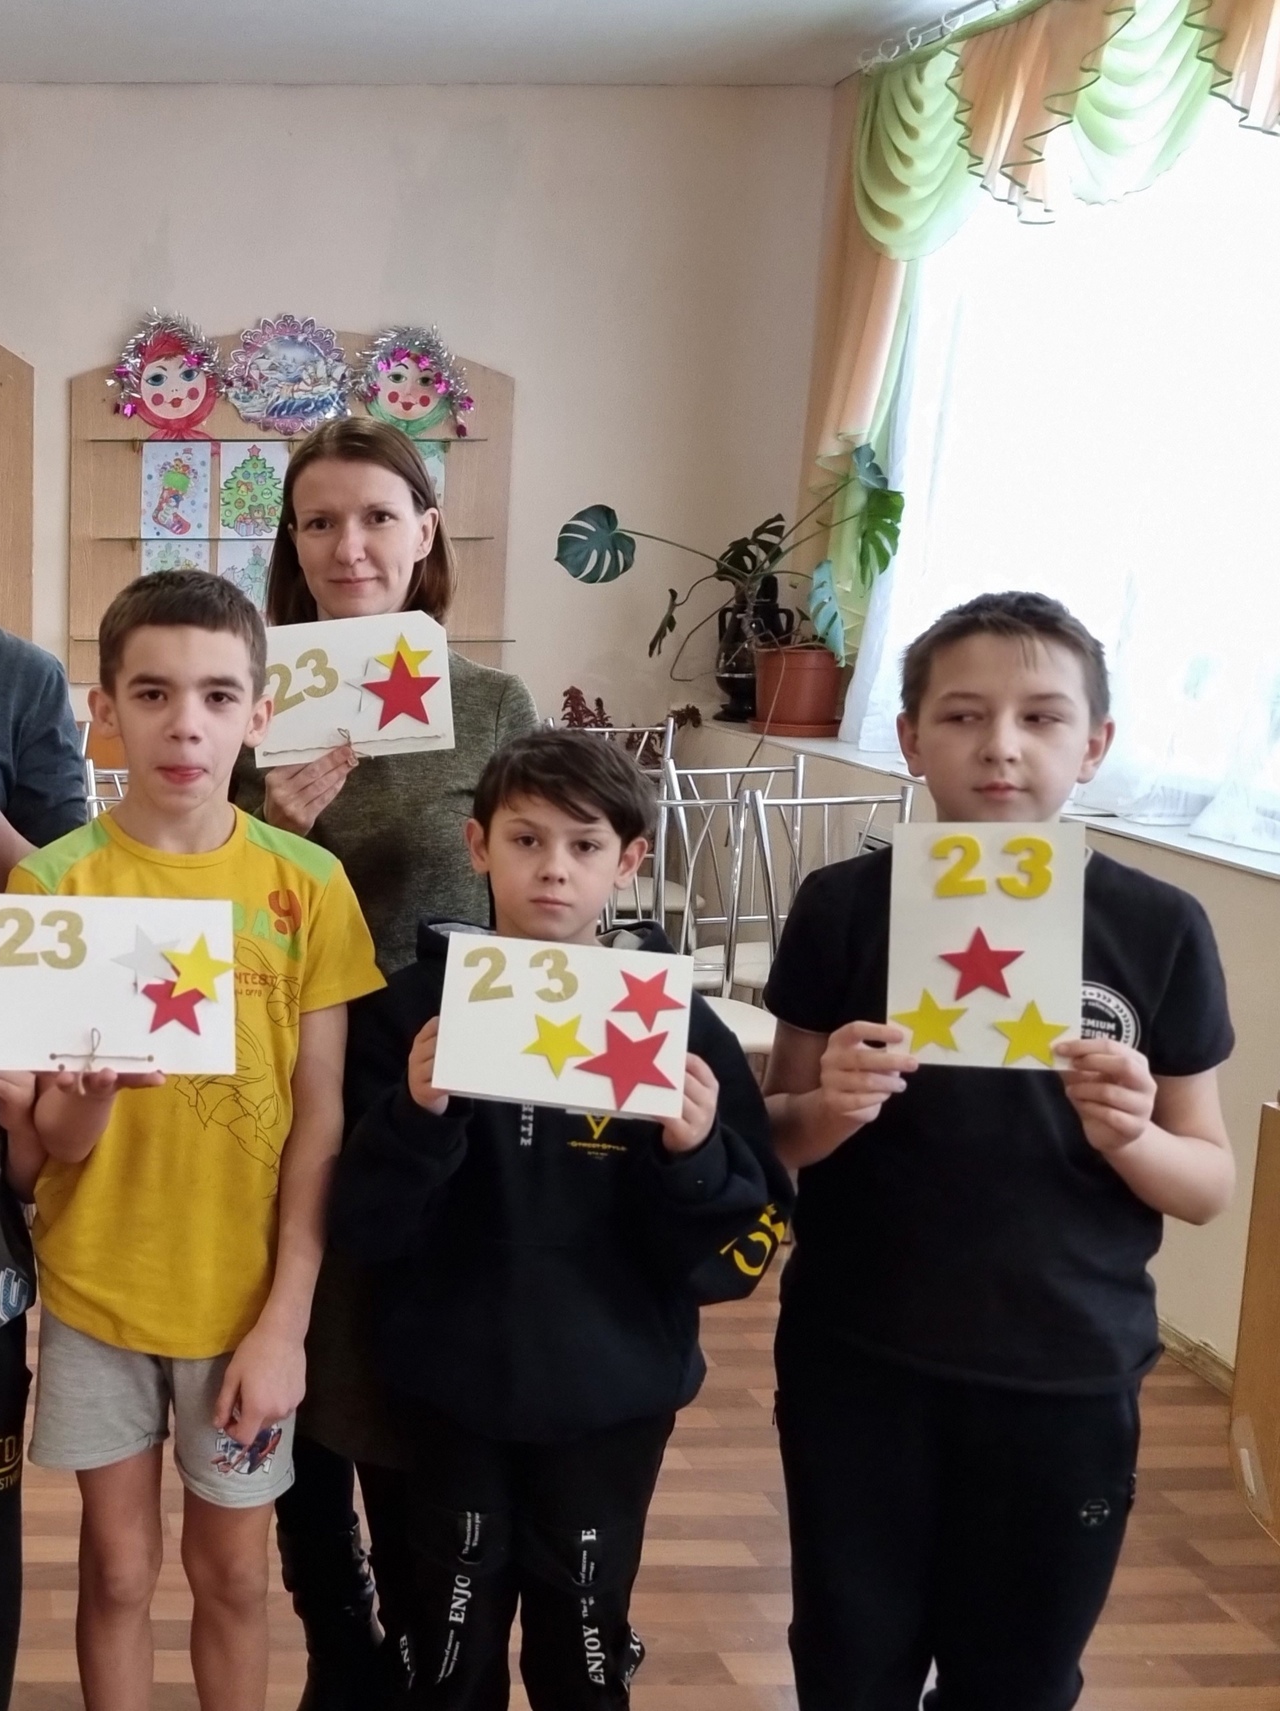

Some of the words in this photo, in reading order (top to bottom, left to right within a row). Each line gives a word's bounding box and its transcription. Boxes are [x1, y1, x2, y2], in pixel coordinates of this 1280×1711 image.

[265, 648, 339, 717] 23
[931, 834, 1053, 899] 23
[463, 946, 579, 1003] 23
[449, 1574, 472, 1624] ENJO
[582, 1625, 606, 1685] ENJOY
